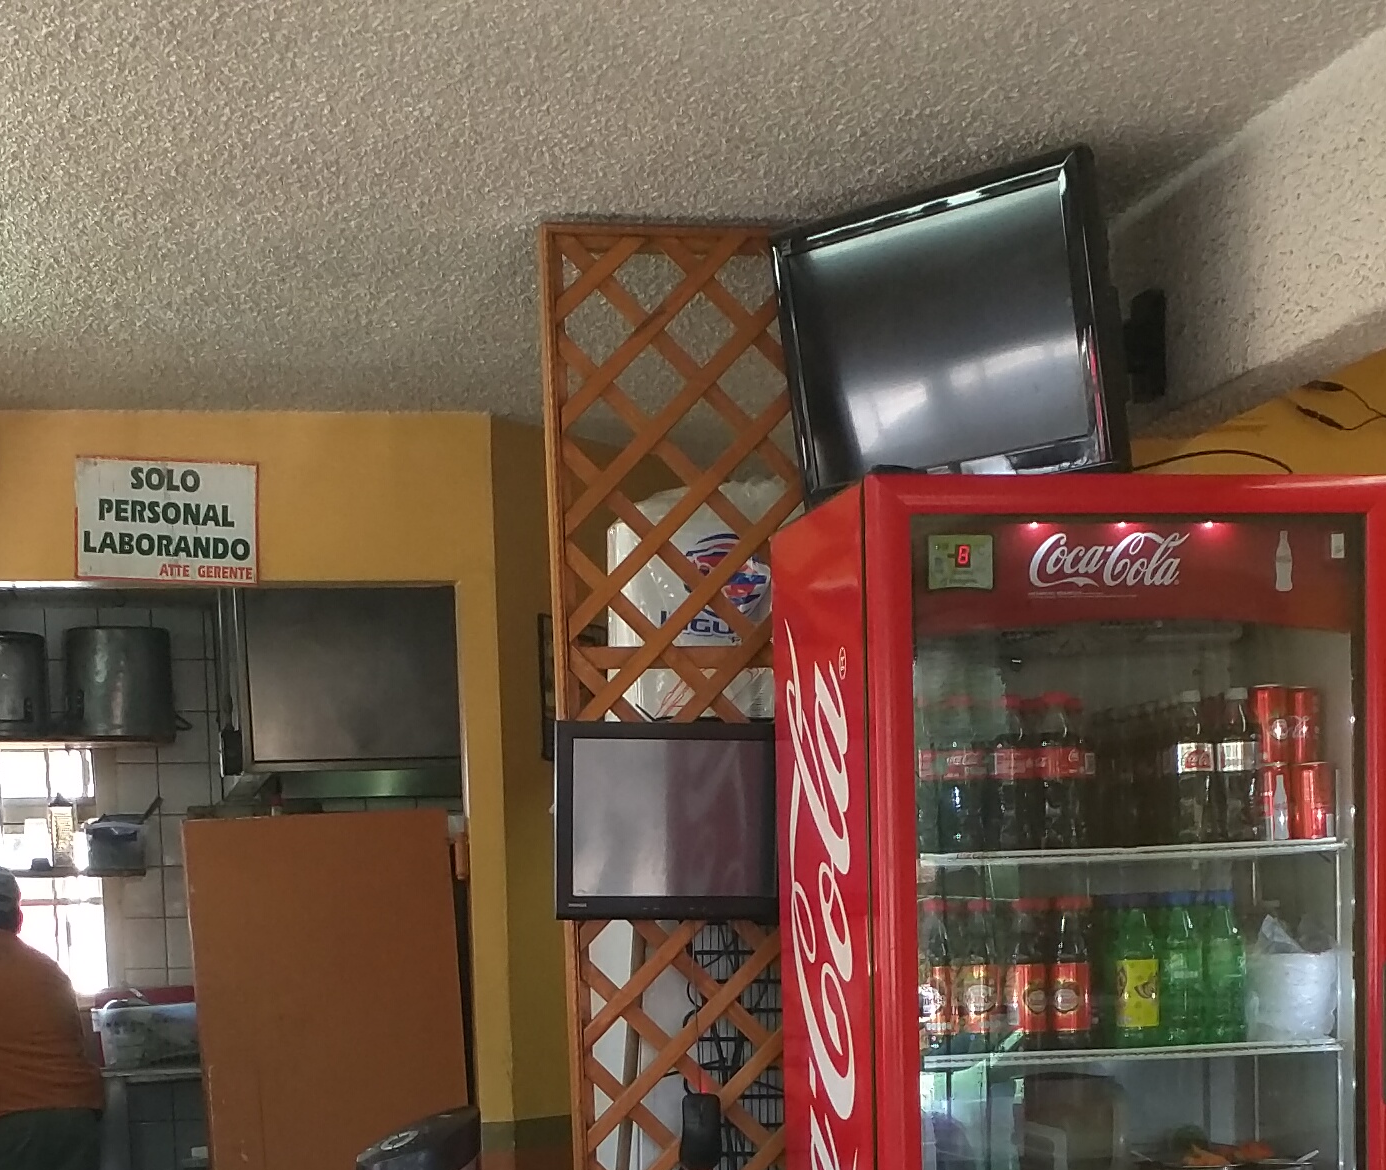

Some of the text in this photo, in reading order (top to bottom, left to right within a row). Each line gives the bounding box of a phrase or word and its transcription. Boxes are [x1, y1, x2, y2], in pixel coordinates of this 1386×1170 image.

[130, 466, 201, 493] SOLO
[98, 498, 235, 528] PERSONAL
[83, 530, 251, 561] LABORANDO
[1028, 532, 1190, 588] Coca-Cola
[159, 563, 253, 580] ATTE GERENTE
